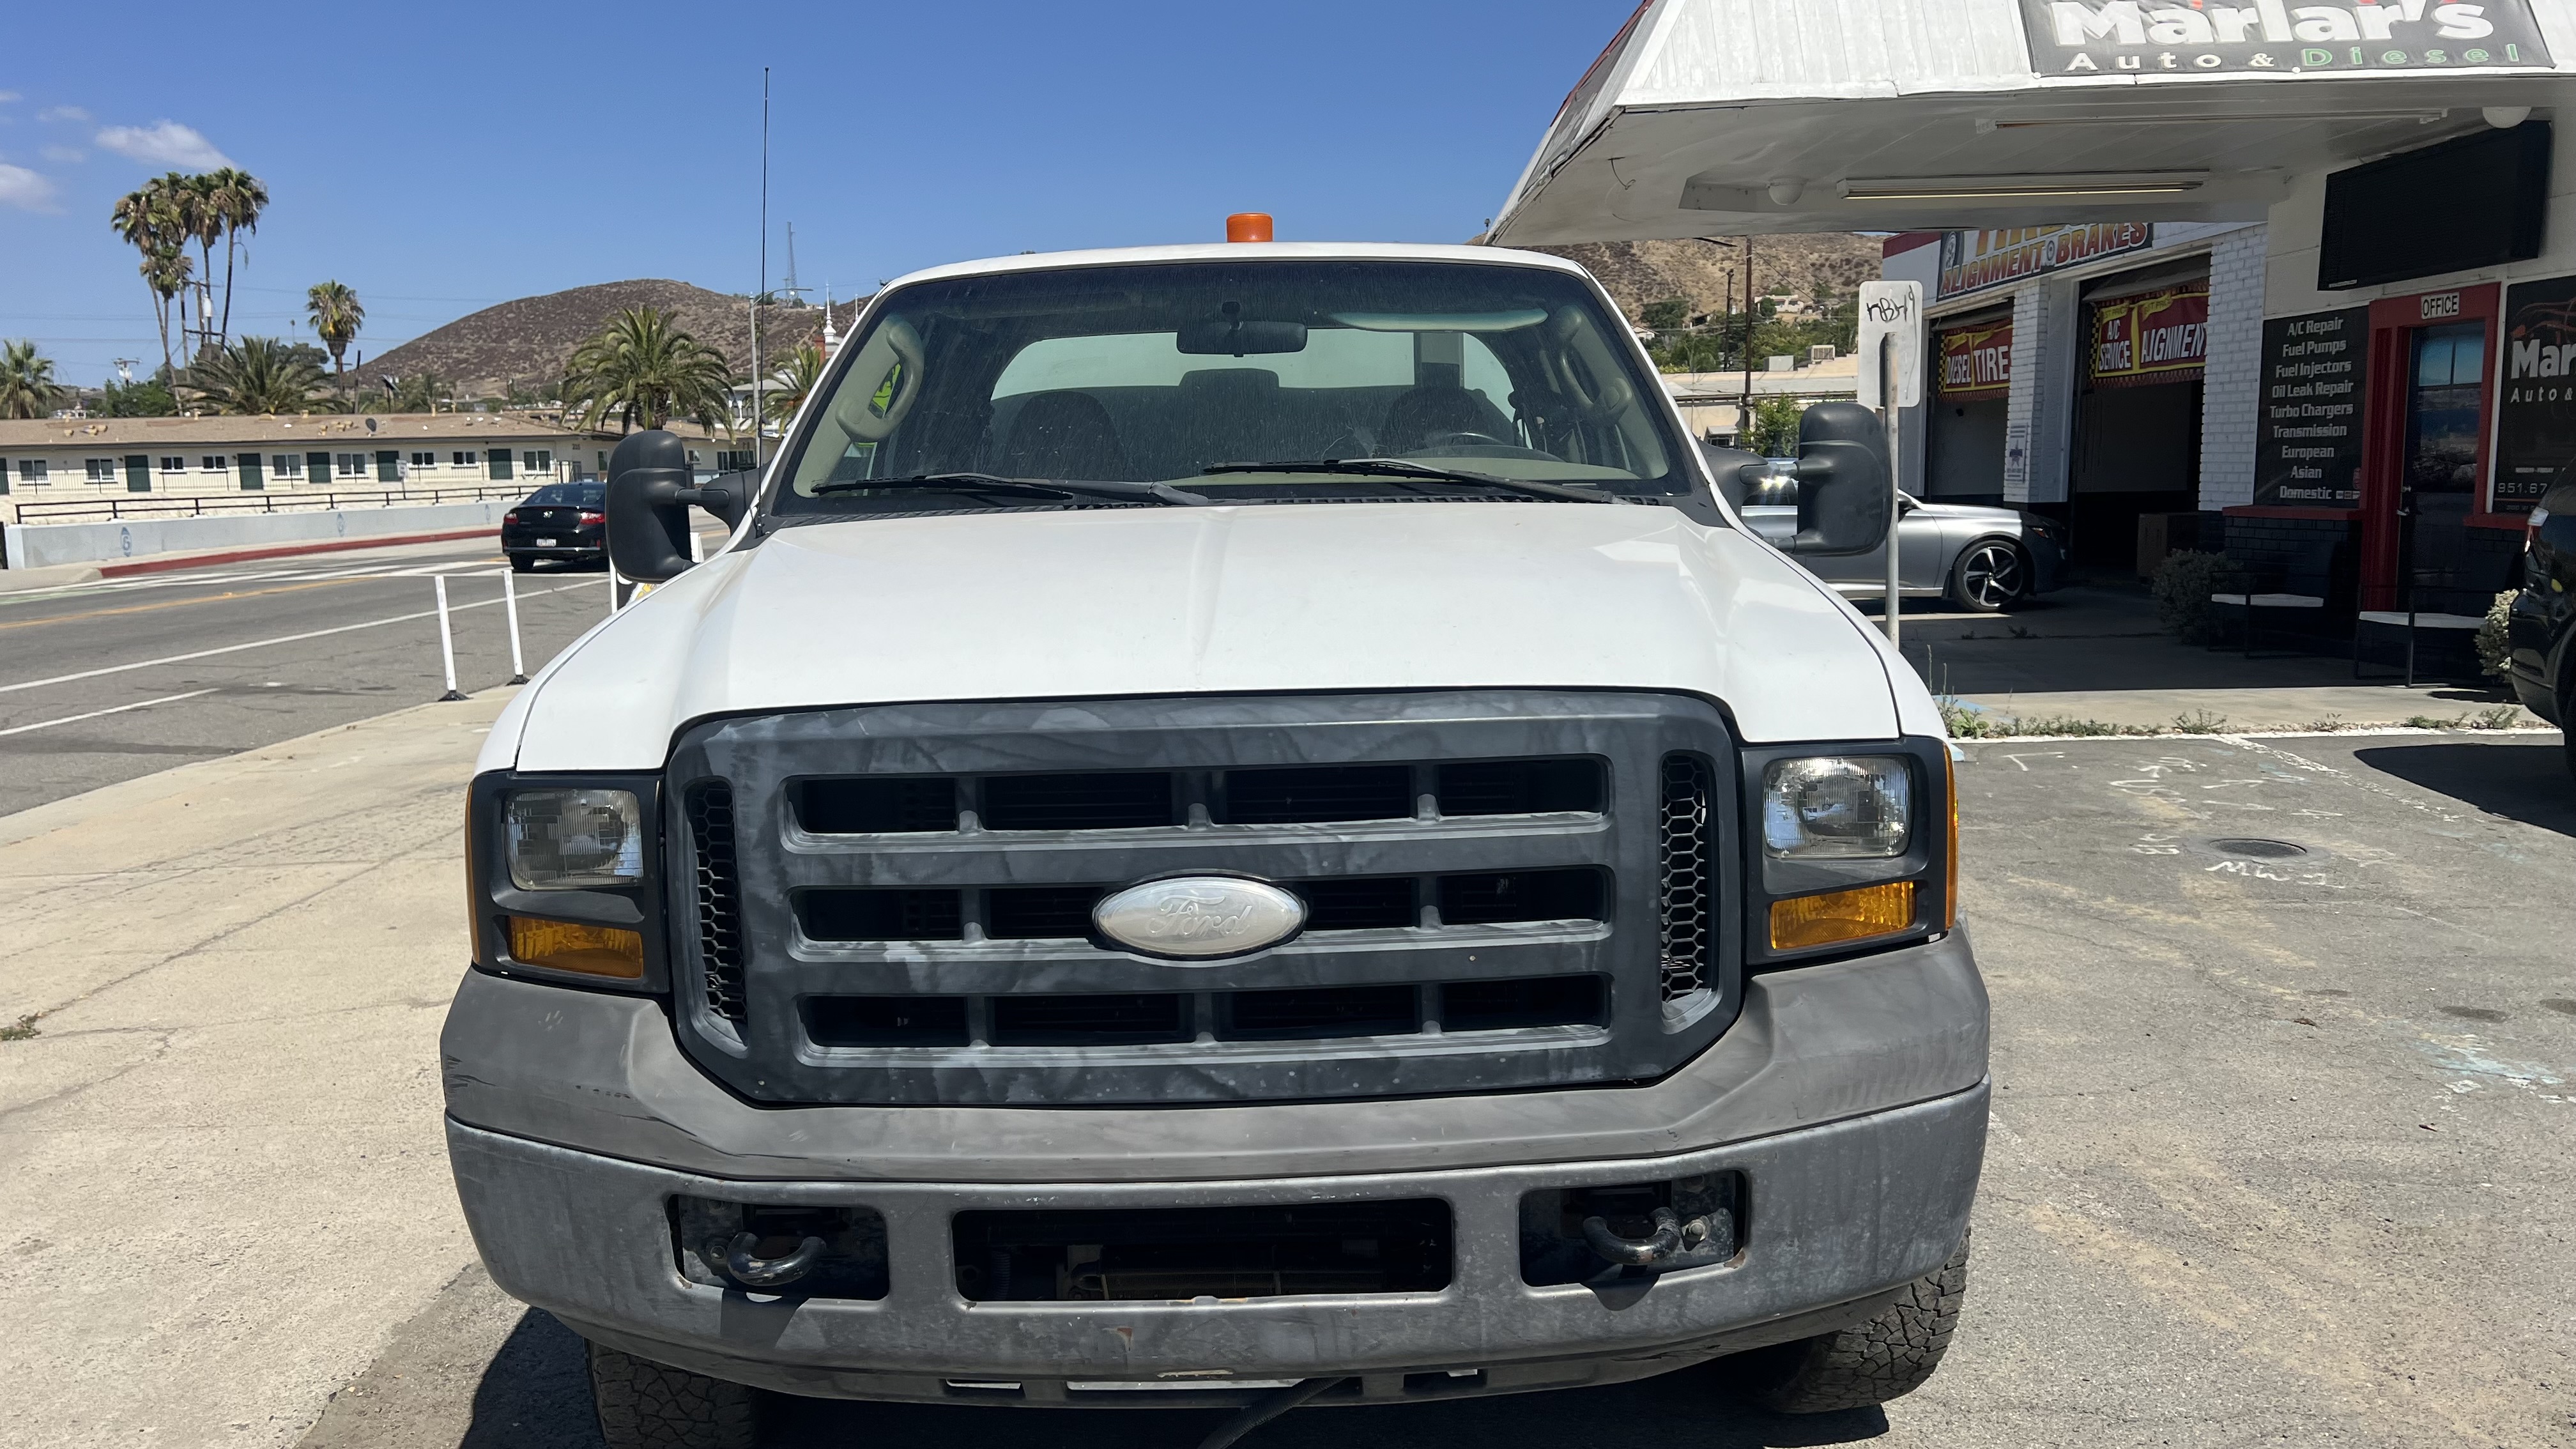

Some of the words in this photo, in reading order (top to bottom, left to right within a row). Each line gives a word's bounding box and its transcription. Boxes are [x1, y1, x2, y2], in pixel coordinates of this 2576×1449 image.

[2053, 0, 2495, 47] Marlar's
[2066, 51, 2222, 72] Auto
[2250, 52, 2274, 68] &
[2302, 43, 2520, 66] Diesel
[1941, 241, 2045, 295] ALIGNMENT
[2055, 222, 2148, 264] BRAKES
[2423, 295, 2458, 318] OFFICE
[2107, 319, 2120, 340] A/C
[2287, 322, 2304, 337] A/C
[2306, 317, 2344, 335] Repair
[2099, 340, 2131, 371] SERVICE
[2283, 342, 2304, 357] Fuel
[2307, 340, 2347, 355] Pumps
[1946, 355, 1972, 384] DIESEL
[1974, 345, 2013, 383] TIRE
[2276, 363, 2298, 378] Fuel
[2299, 361, 2352, 378] Injectors
[2272, 385, 2286, 399] Oil
[2287, 383, 2313, 397] Leak
[2315, 379, 2354, 397] Repair
[2510, 387, 2557, 402] Auto
[2270, 404, 2300, 418] Turbo
[2301, 403, 2354, 419] Chargers
[2273, 424, 2347, 438] Transmission
[2281, 445, 2335, 461] European
[2290, 465, 2322, 479] Asian
[2280, 486, 2333, 500] Domestic
[1149, 895, 1252, 937] Ford
